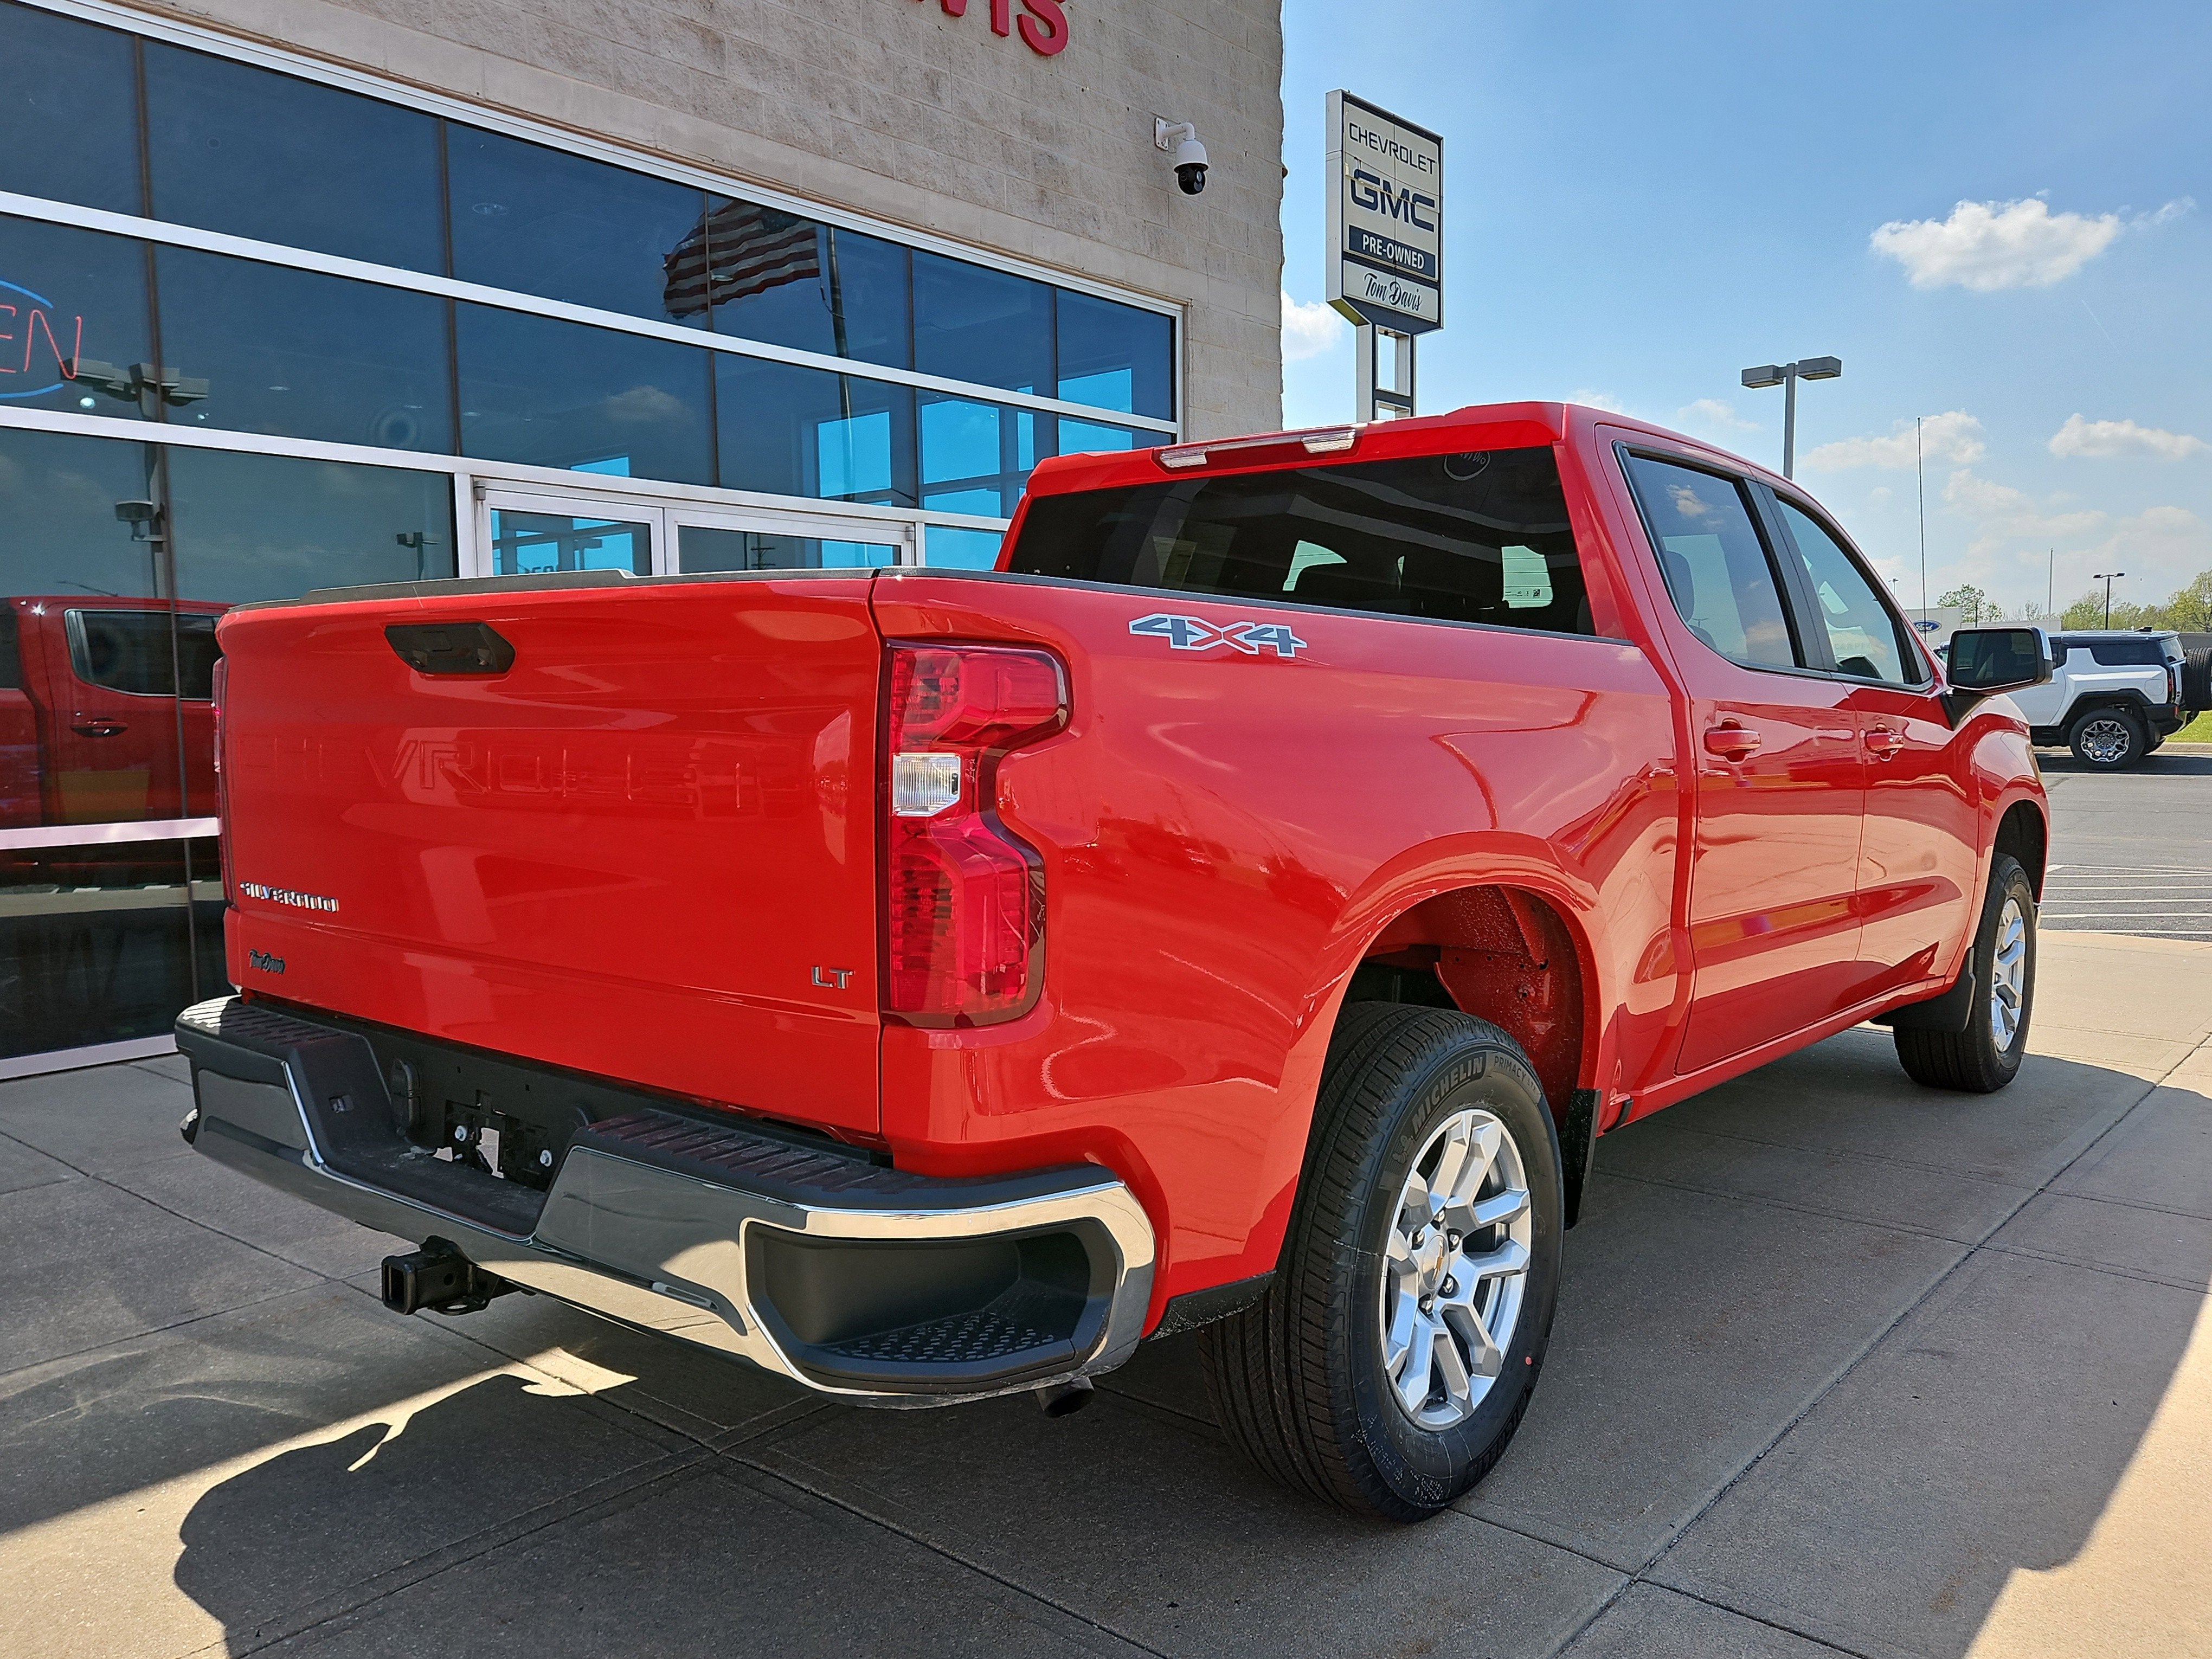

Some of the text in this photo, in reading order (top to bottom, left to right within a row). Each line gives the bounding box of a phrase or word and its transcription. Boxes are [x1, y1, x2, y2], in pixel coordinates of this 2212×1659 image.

[1349, 122, 1436, 175] CHEVROLET
[1350, 168, 1436, 233] GMC
[1362, 233, 1425, 270] PRE-OWNED
[1364, 272, 1423, 312] Tom Davis
[240, 882, 339, 912] SILVERADO
[811, 966, 855, 989] LT
[1494, 1056, 1526, 1082] PRIMACY
[1411, 1056, 1483, 1134] MICHELIN
